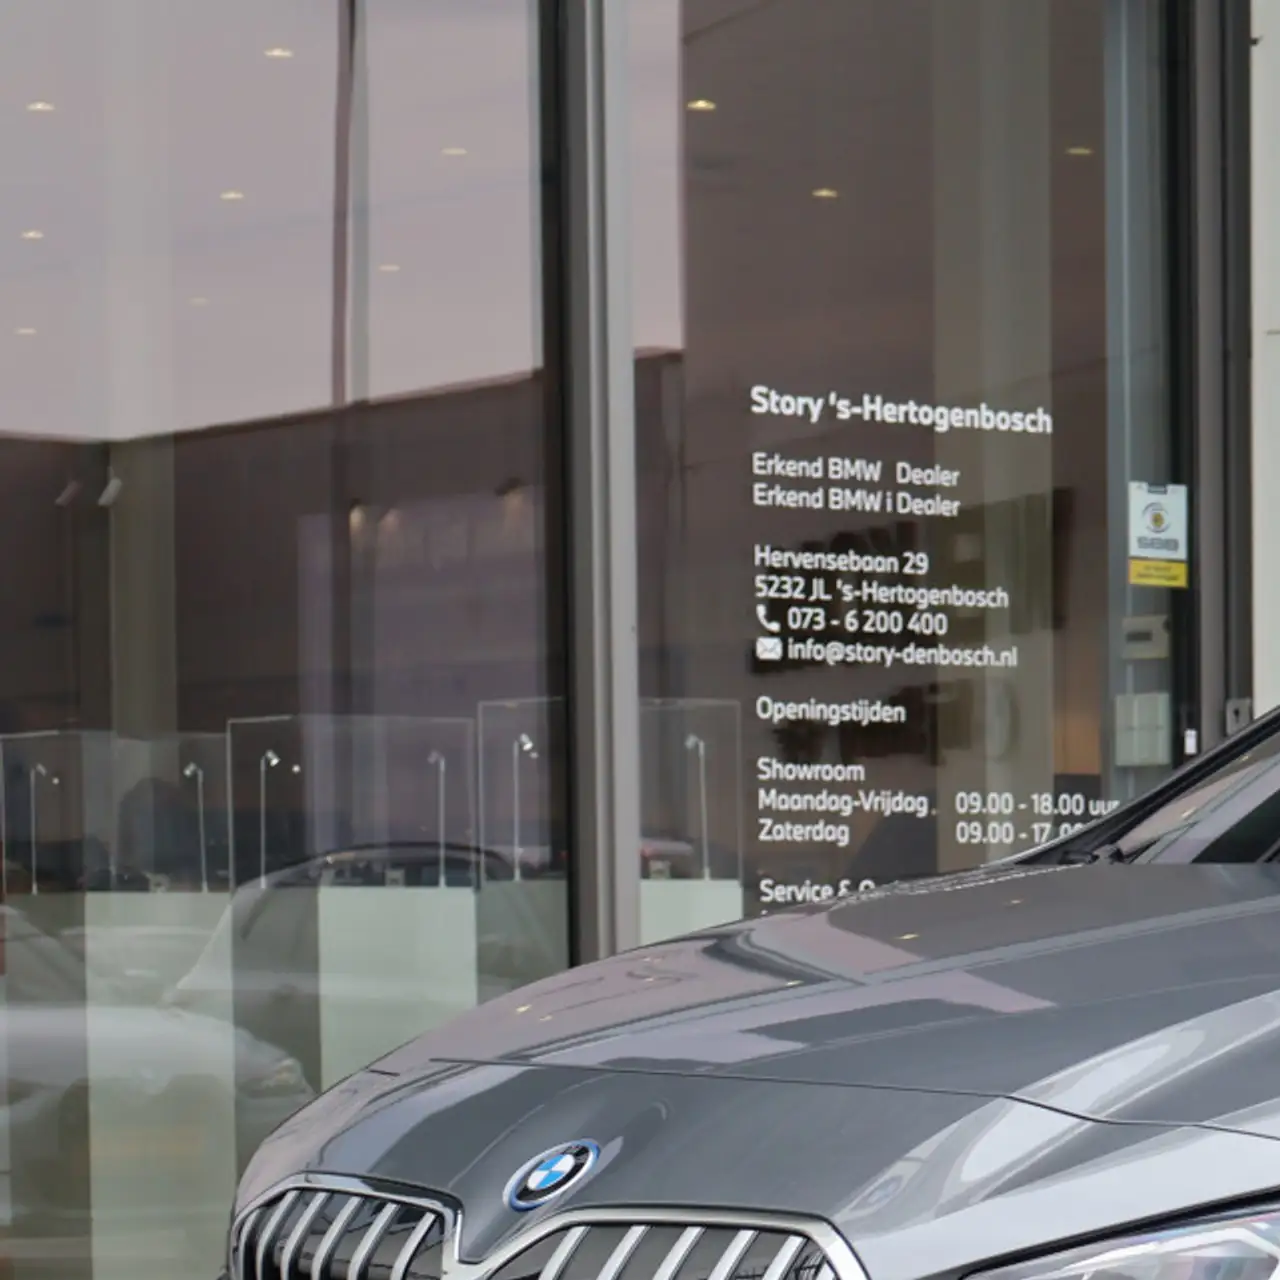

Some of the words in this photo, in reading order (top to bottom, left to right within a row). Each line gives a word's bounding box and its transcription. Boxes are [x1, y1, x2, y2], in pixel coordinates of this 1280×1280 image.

[750, 385, 824, 423] Story
[829, 391, 1053, 434] 's-Hertogenbosch
[752, 452, 823, 479] Erkend
[828, 457, 882, 482] BMW
[896, 462, 960, 486] Dealer
[752, 483, 824, 510] Erkend
[829, 488, 883, 513] BMW
[885, 491, 892, 513] i
[896, 491, 961, 517] Dealer
[754, 544, 899, 574] Hervensebaan
[902, 551, 929, 575] 29
[754, 575, 805, 600] 5232
[808, 578, 832, 601] JL
[836, 578, 1009, 609] 's-Hertogenbosch
[787, 607, 825, 630] 073
[844, 610, 859, 632] 6
[863, 610, 903, 633] 200
[907, 612, 948, 635] 400
[787, 637, 1018, 667] info@story-denbosch.nl
[755, 695, 907, 726] Openingstijden
[756, 756, 865, 781] Showroom
[758, 788, 928, 818] Maandag-Vrijdag
[955, 791, 1014, 815] 09.00
[1030, 792, 1085, 816] 18.00
[758, 818, 850, 847] Zaterdag
[956, 821, 1014, 844] 09.00
[759, 877, 835, 903] Service
